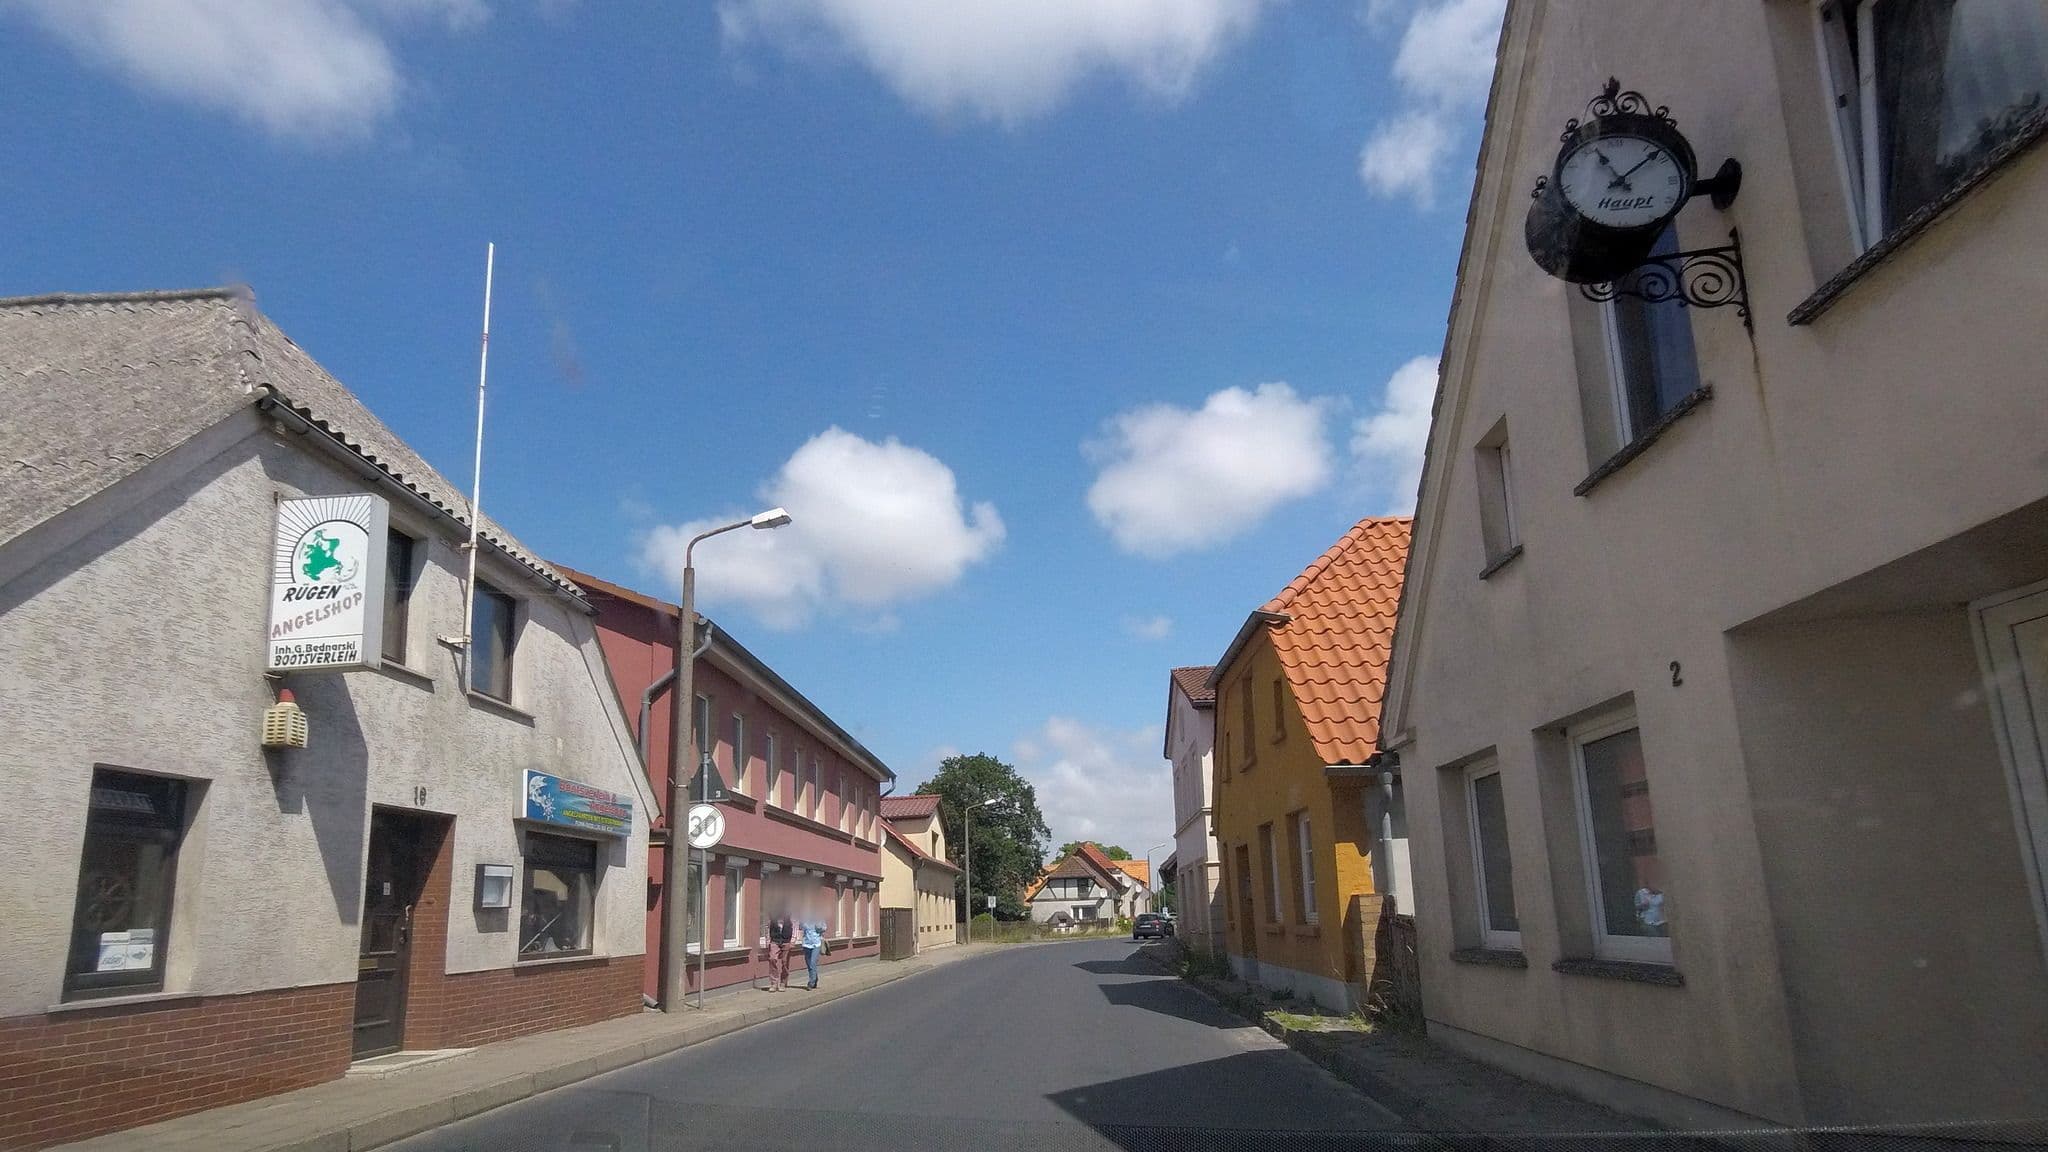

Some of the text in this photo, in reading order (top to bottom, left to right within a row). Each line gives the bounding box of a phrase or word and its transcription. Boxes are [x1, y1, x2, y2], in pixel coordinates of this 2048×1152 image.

[1597, 196, 1653, 210] Haupt
[282, 583, 342, 602] RÜGEN
[272, 591, 363, 638] ANGELSHOP
[274, 650, 358, 667] BOOTSVERLEIH
[1670, 660, 1683, 687] 2
[690, 815, 717, 838] 30
